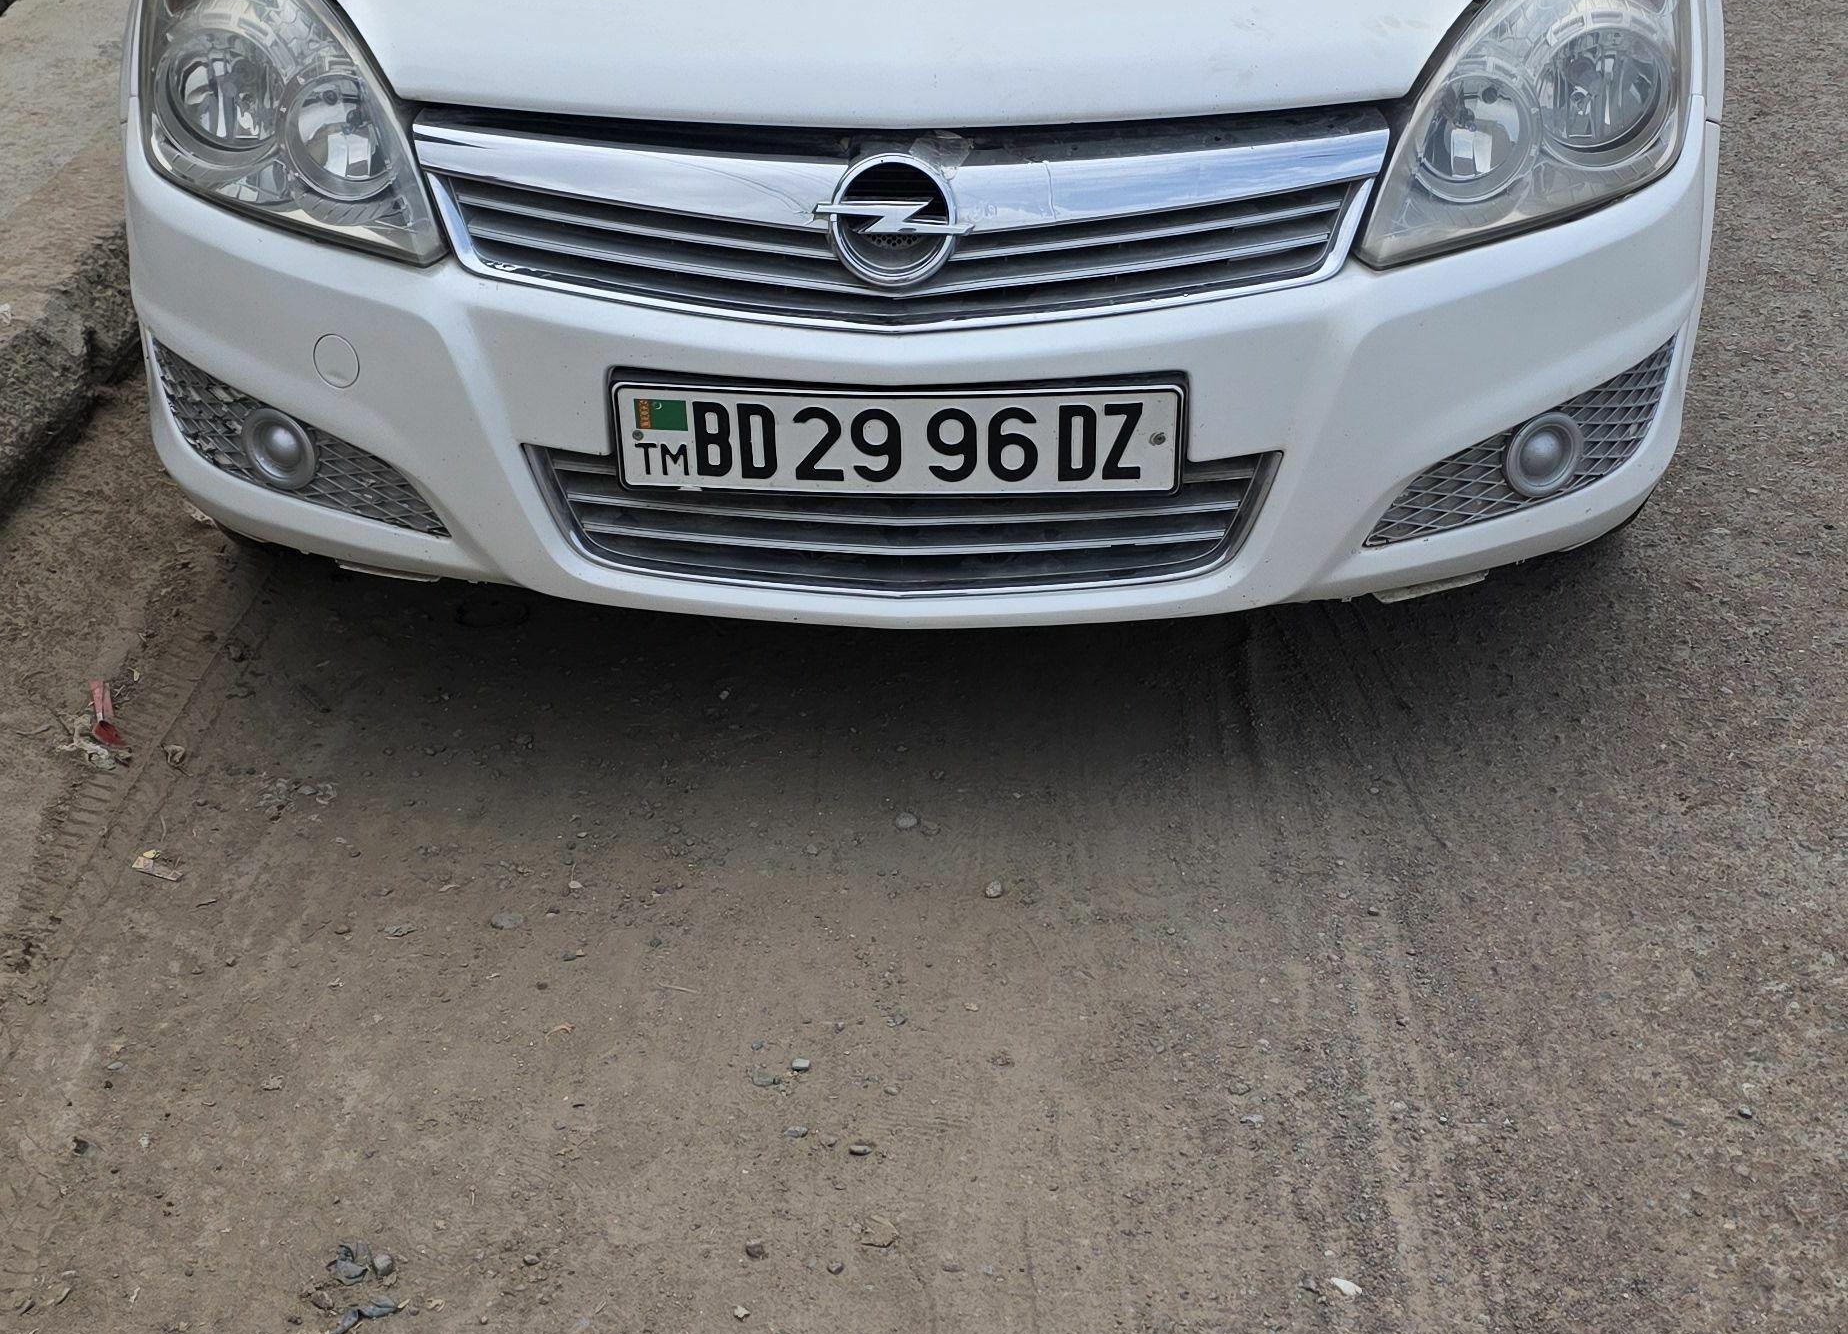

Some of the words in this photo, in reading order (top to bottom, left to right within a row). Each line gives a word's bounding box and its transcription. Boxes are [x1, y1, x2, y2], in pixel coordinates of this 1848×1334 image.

[634, 442, 690, 477] TM
[692, 401, 776, 479] BD
[792, 406, 902, 482] 29
[926, 407, 1038, 482] 96
[1057, 403, 1144, 480] DZ
